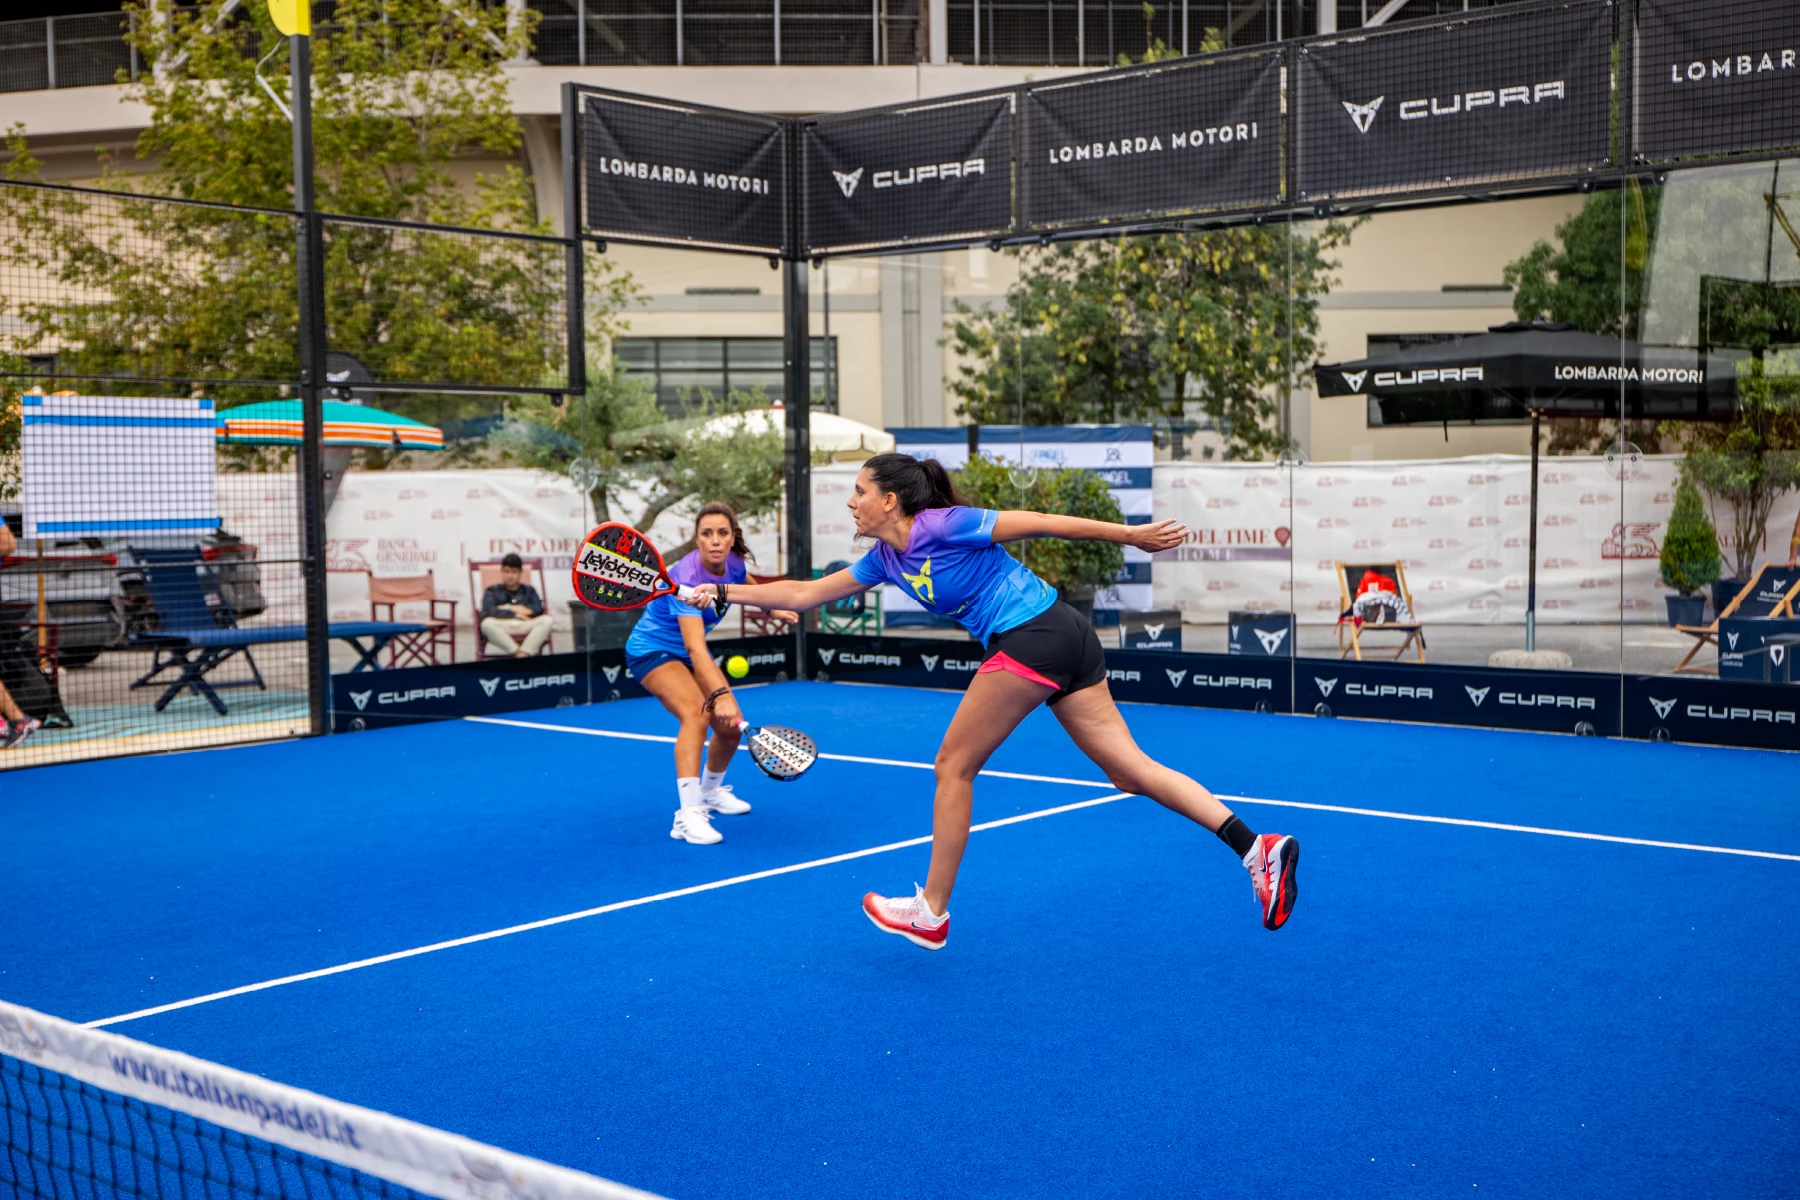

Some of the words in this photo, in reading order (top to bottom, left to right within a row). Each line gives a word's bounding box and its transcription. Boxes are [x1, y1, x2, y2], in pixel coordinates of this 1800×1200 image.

[1671, 48, 1797, 83] LOMBAR
[1400, 80, 1565, 121] CUPRA
[1049, 135, 1162, 164] LOMBARDA
[1172, 122, 1258, 149] MOTORI
[600, 157, 698, 187] LOMBARDA
[703, 171, 769, 195] MOTORI
[872, 158, 985, 189] CUPRA
[1374, 366, 1484, 387] CUPRA
[1555, 365, 1639, 381] LOMBARDA
[1642, 367, 1704, 384] MOTORI
[377, 538, 418, 550] BANCA
[1184, 529, 1221, 544] DEL
[1224, 529, 1271, 544] TIME
[489, 538, 522, 553] IT'S
[377, 550, 437, 563] GENERALI
[1177, 549, 1235, 560] HOME
[747, 653, 785, 666] PRA
[839, 653, 901, 666] CUPRA
[944, 659, 982, 671] CUP
[505, 674, 575, 691] CUPRA
[1193, 674, 1272, 690] CUPRA
[378, 686, 456, 704] CUPRA
[1345, 683, 1433, 699] CUPRA
[1499, 692, 1596, 709] CUPRA
[1687, 704, 1796, 724] CUPRA
[107, 1052, 361, 1151] www.italianpadel.it
